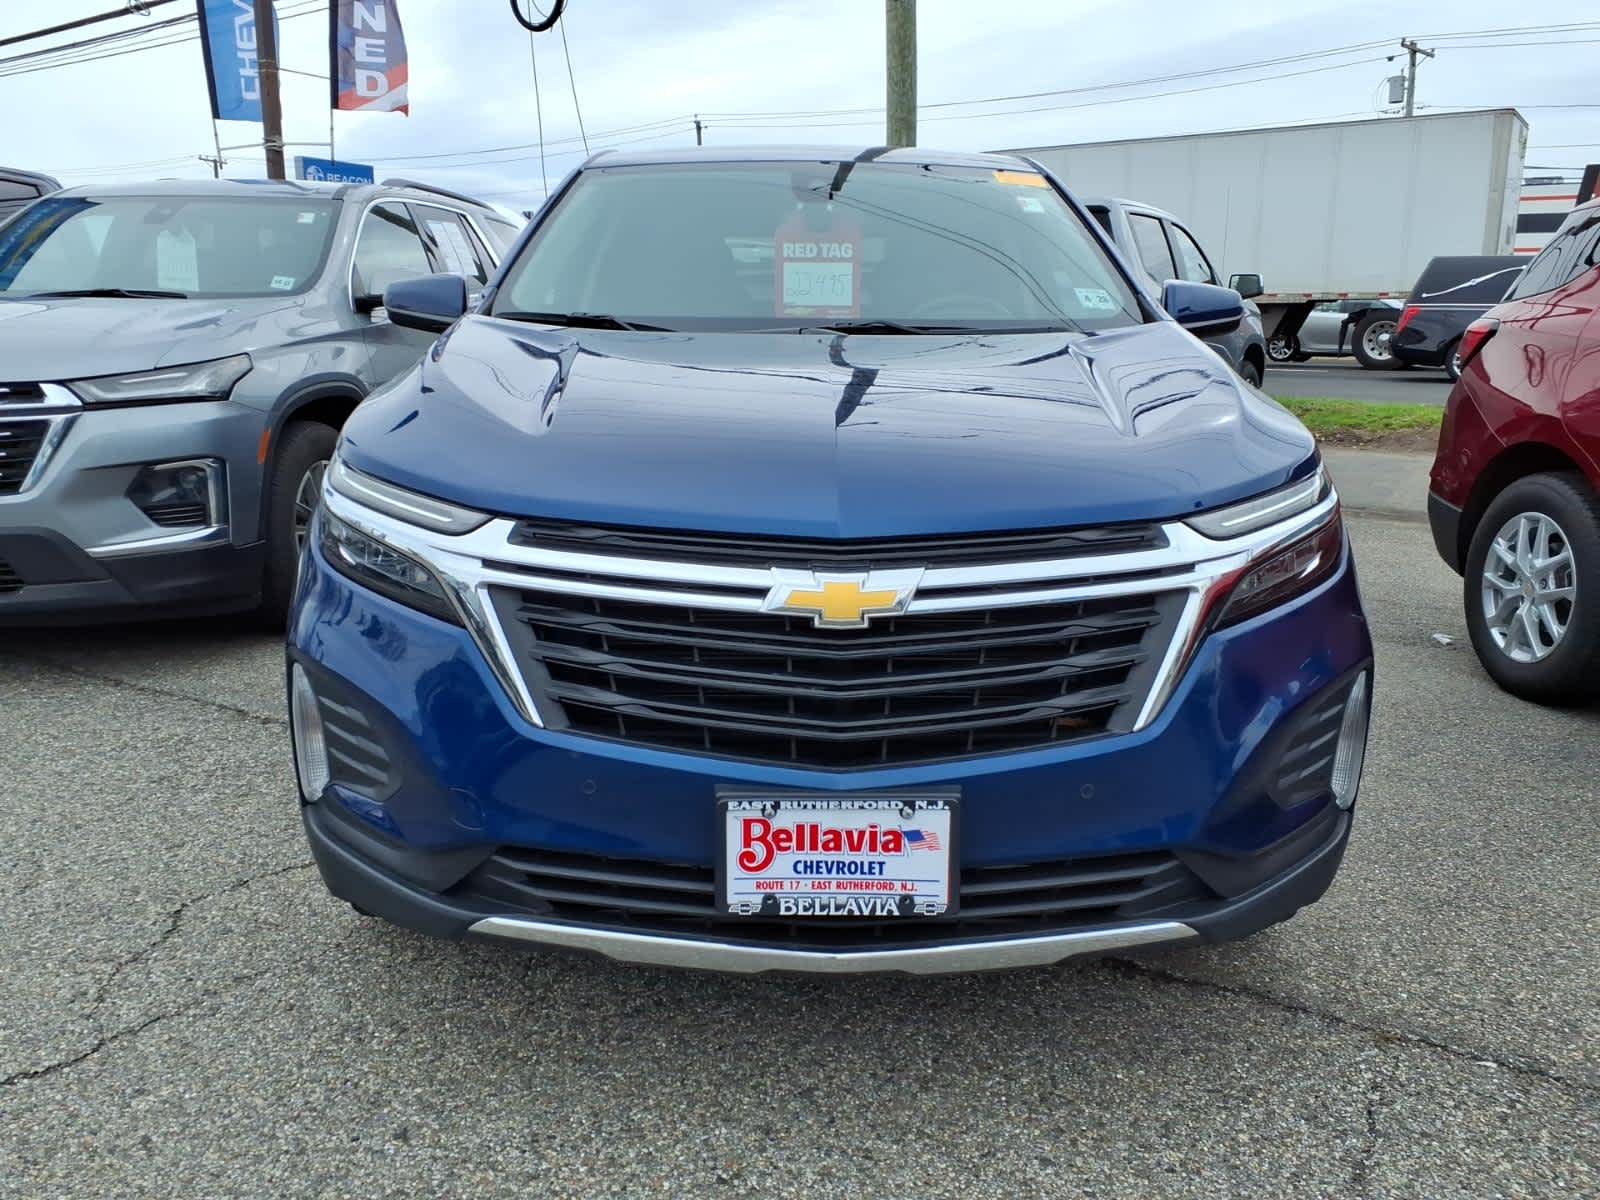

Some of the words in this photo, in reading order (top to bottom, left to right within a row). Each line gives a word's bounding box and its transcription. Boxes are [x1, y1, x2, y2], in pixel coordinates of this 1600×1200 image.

[783, 242, 817, 258] RED
[819, 242, 854, 258] TAG
[727, 800, 775, 810] EAST
[915, 800, 949, 810] N.J.
[737, 817, 905, 872] Bellavia
[793, 860, 886, 876] CHEVROLET
[755, 881, 785, 891] ROUTE
[789, 881, 801, 891] 17
[811, 881, 832, 891] EAST
[835, 881, 897, 892] RUTHERFORD,
[900, 882, 918, 892] N.J.
[778, 896, 901, 916] BELLAVIA
